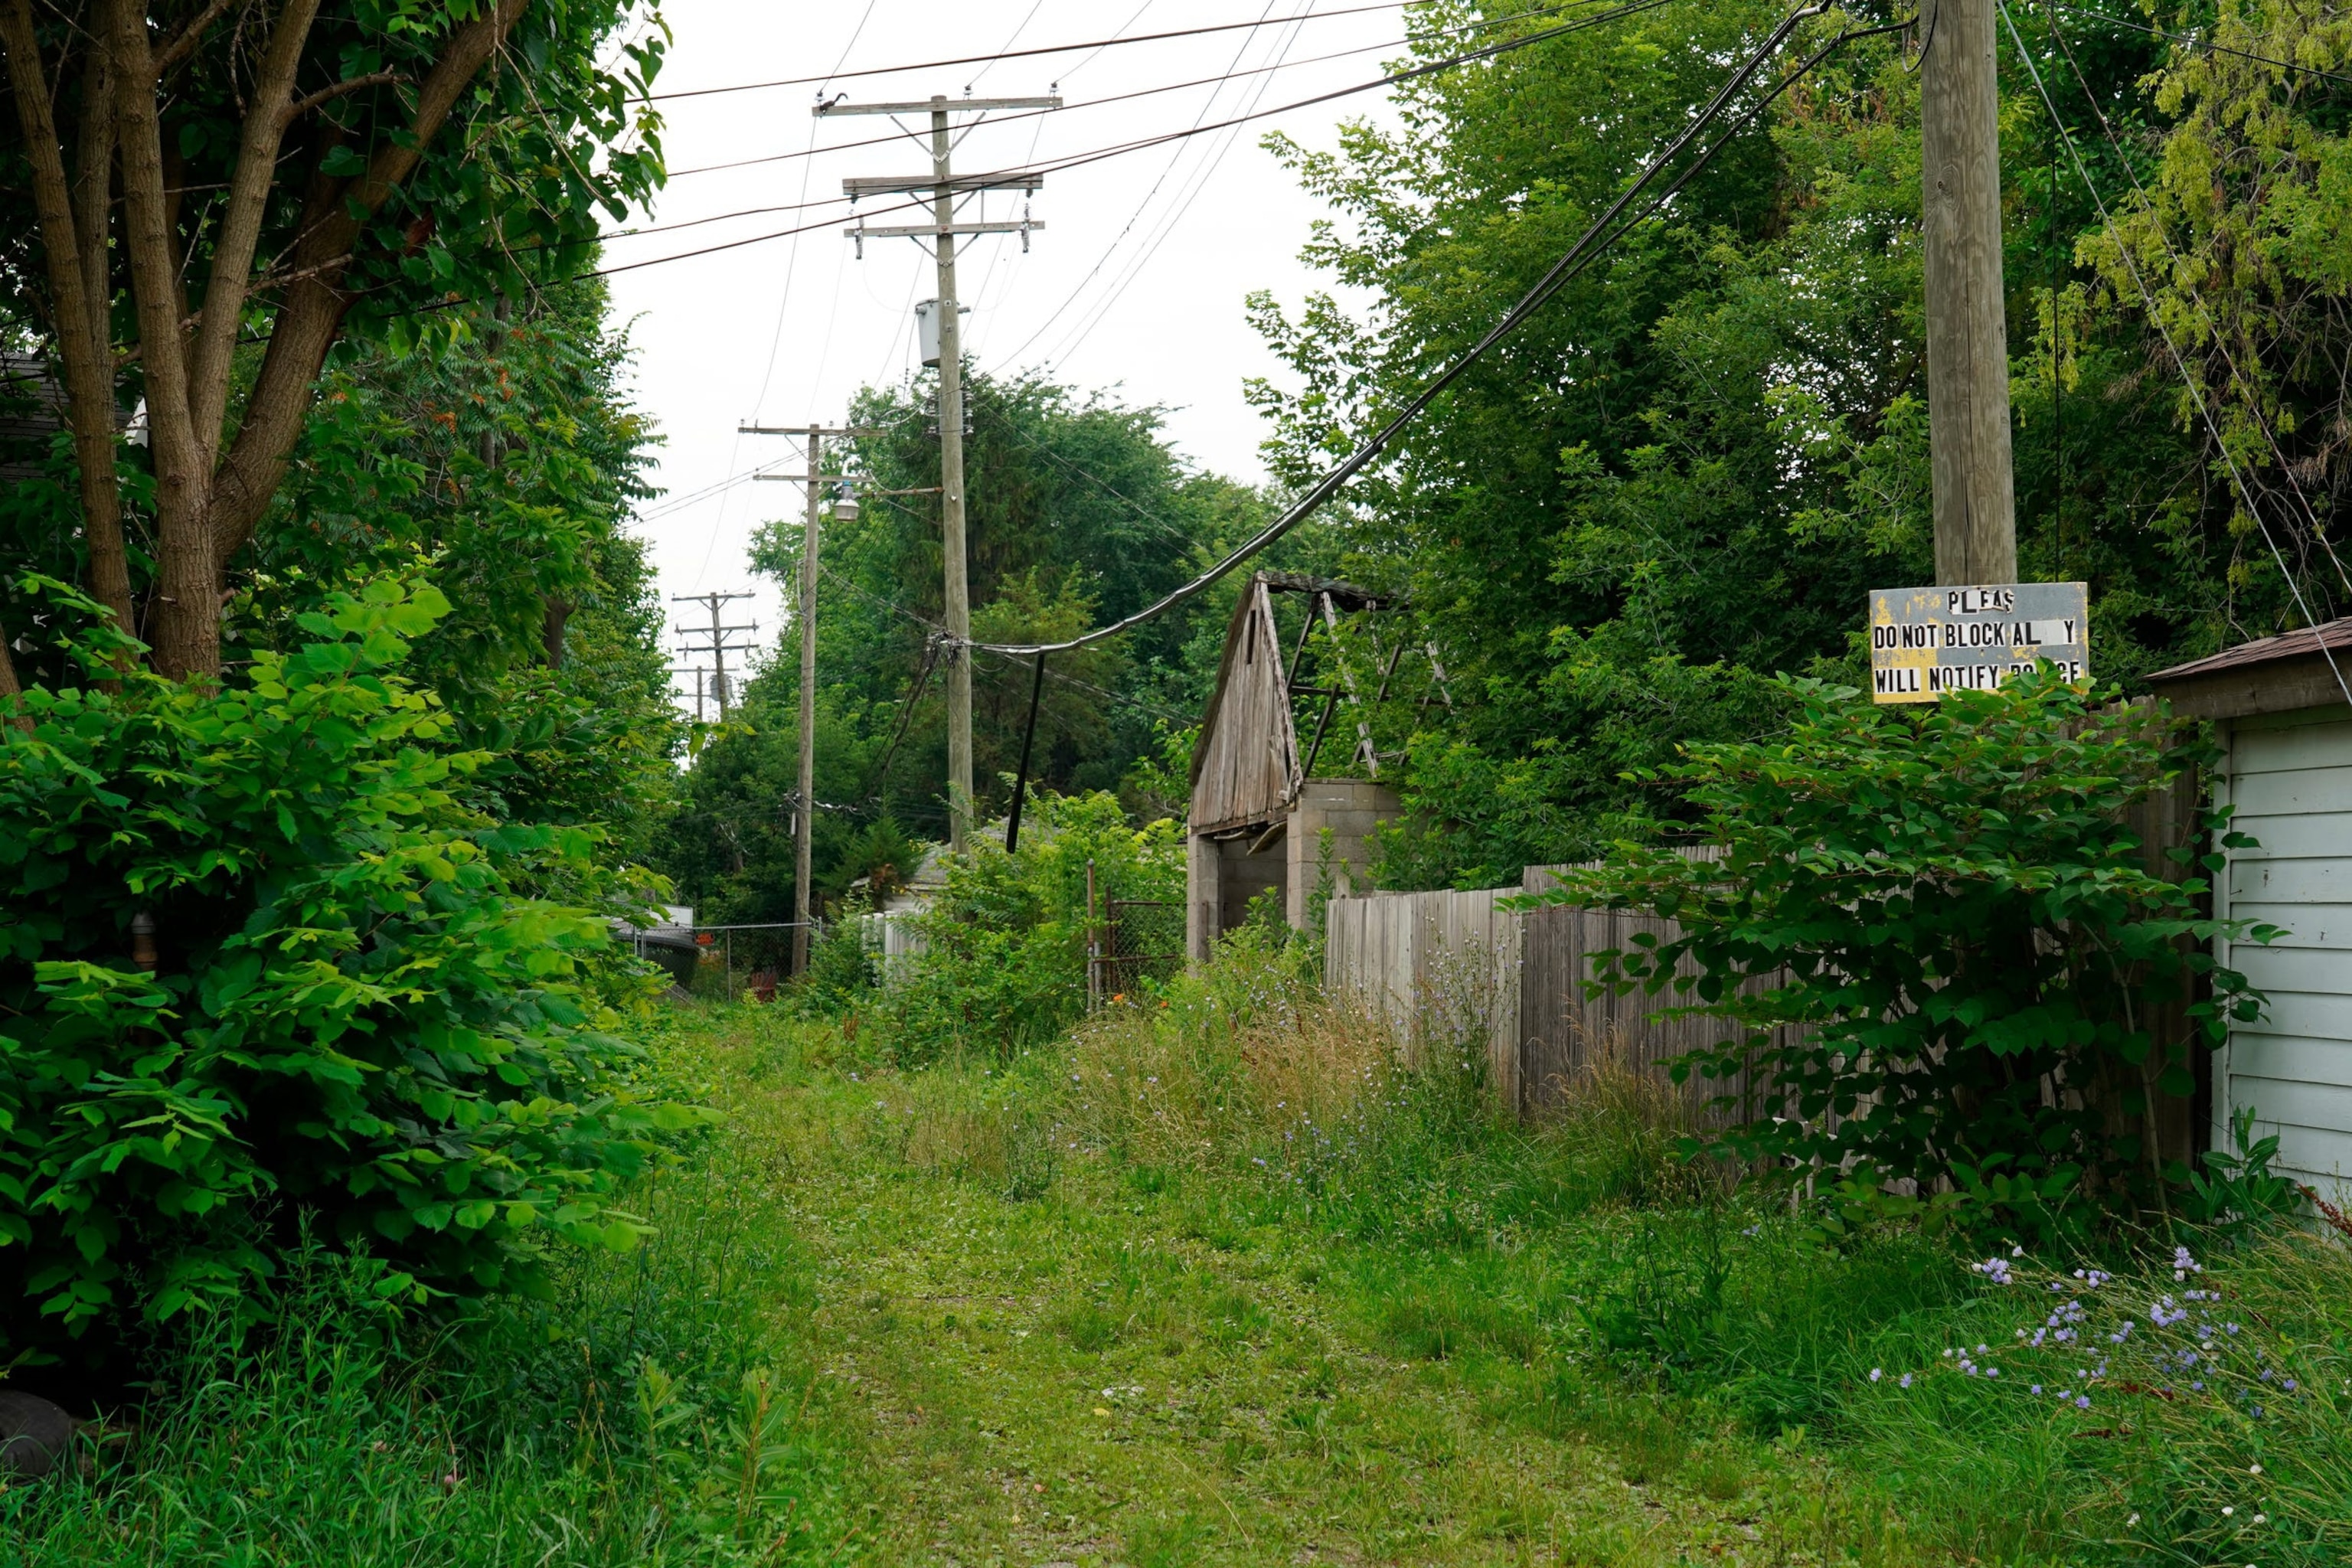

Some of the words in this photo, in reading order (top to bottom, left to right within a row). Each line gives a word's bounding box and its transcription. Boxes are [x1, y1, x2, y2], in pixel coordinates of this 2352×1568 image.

[1874, 626, 1897, 648] DO
[1902, 625, 1937, 648] NOT
[1945, 622, 2004, 647] BLOCK
[1876, 669, 1919, 692] WILL
[1929, 665, 1998, 691] NOTIFY
